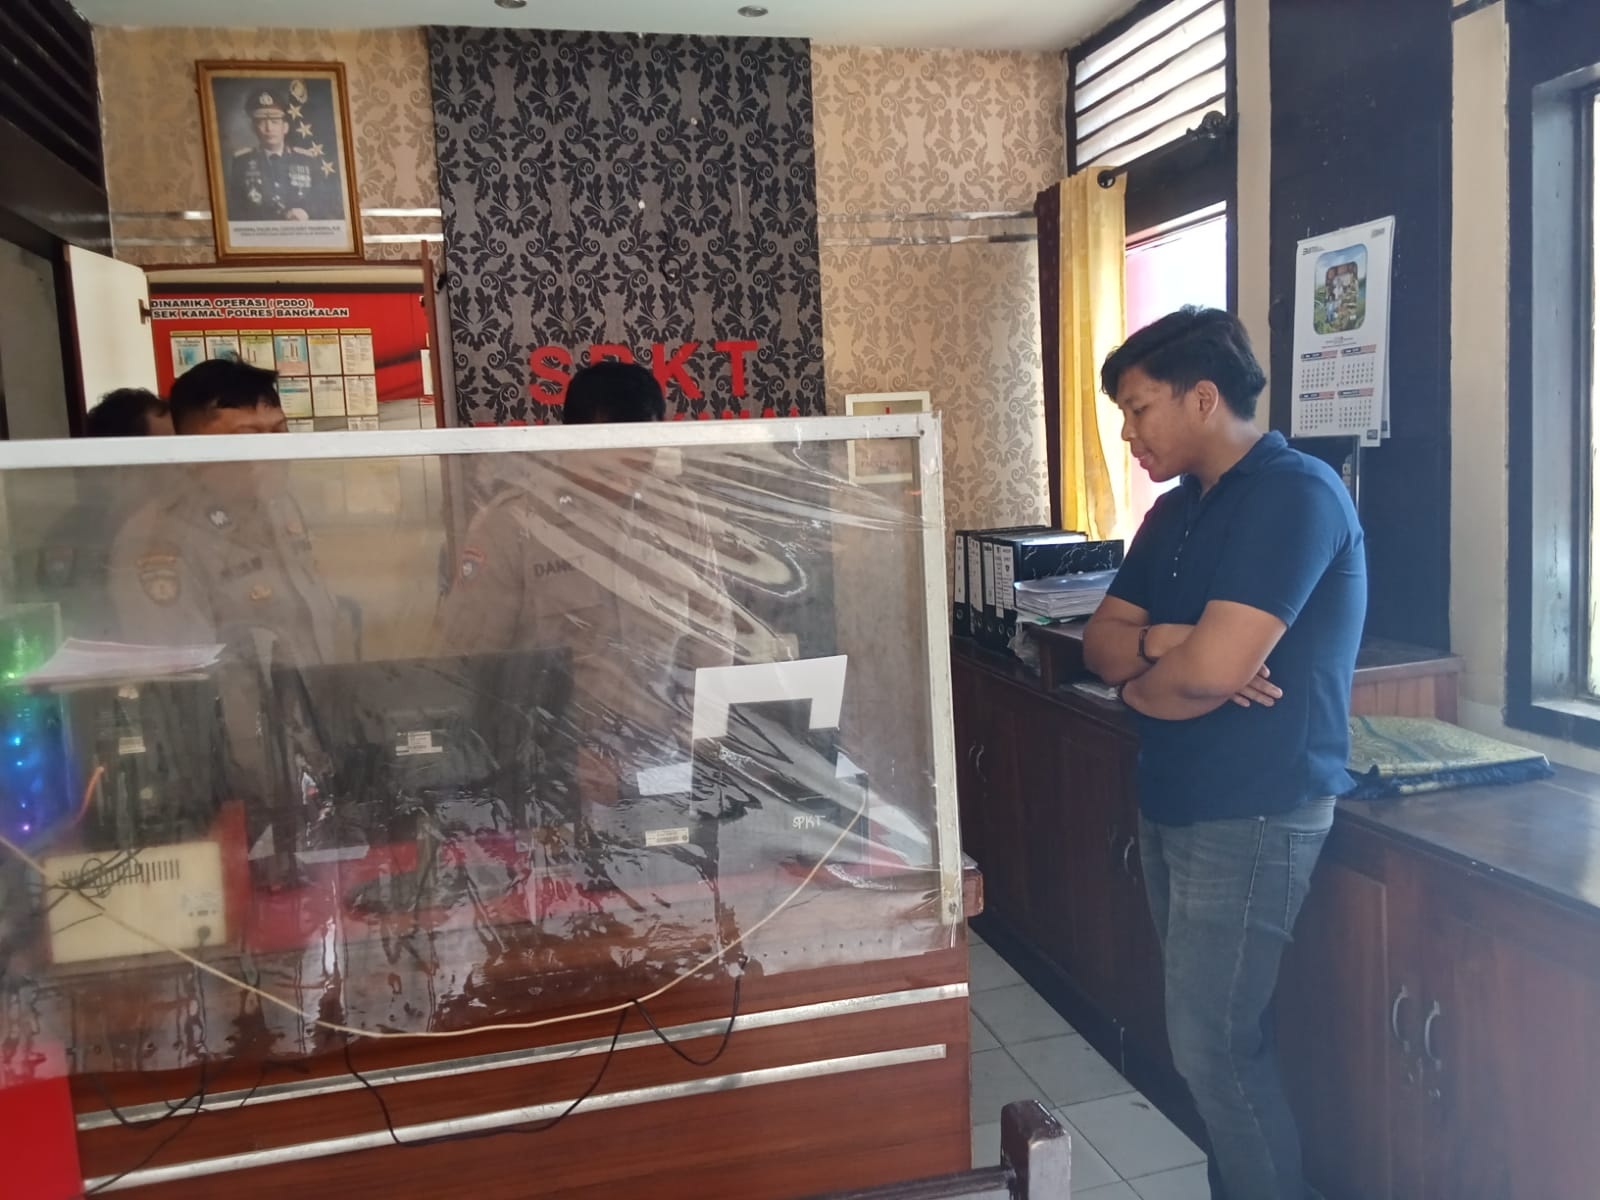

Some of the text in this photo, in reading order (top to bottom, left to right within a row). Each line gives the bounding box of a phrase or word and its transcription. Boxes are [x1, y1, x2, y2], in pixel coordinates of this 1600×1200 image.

[150, 300, 211, 308] DINAMIKA
[214, 299, 266, 308] OPERASI
[181, 309, 224, 318] KAMAL
[226, 308, 273, 317] POLRES
[276, 308, 348, 317] BANGKALAN
[792, 814, 826, 830] SPKT
